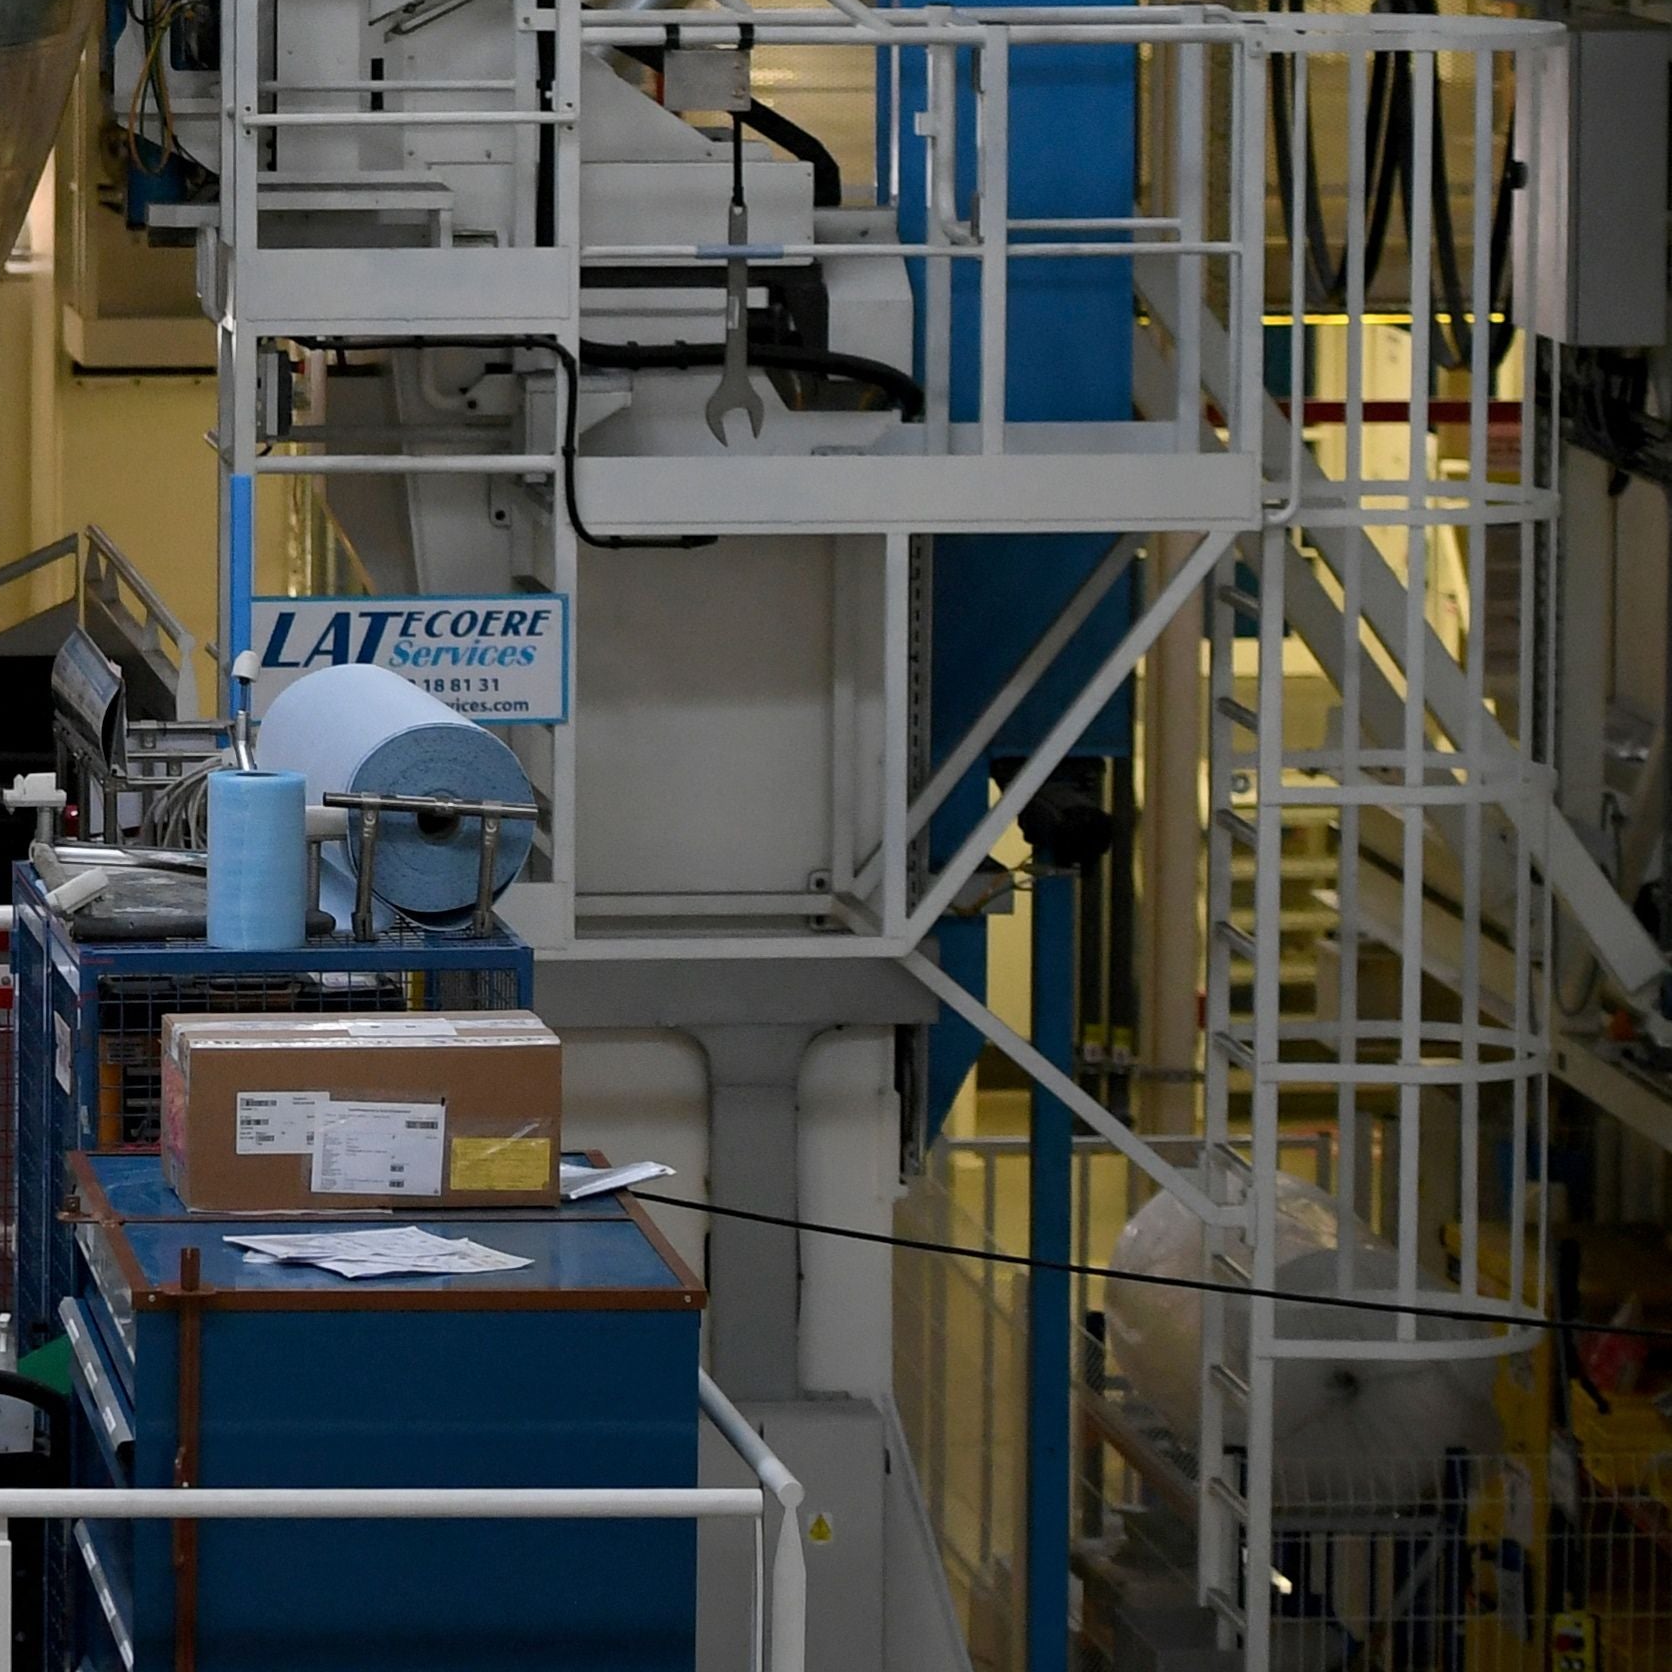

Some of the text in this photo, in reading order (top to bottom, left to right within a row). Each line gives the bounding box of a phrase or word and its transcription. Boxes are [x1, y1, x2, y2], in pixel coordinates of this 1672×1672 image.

[388, 639, 537, 668] Services
[424, 678, 445, 692] 18
[450, 678, 471, 692] 81
[478, 678, 500, 692] 31
